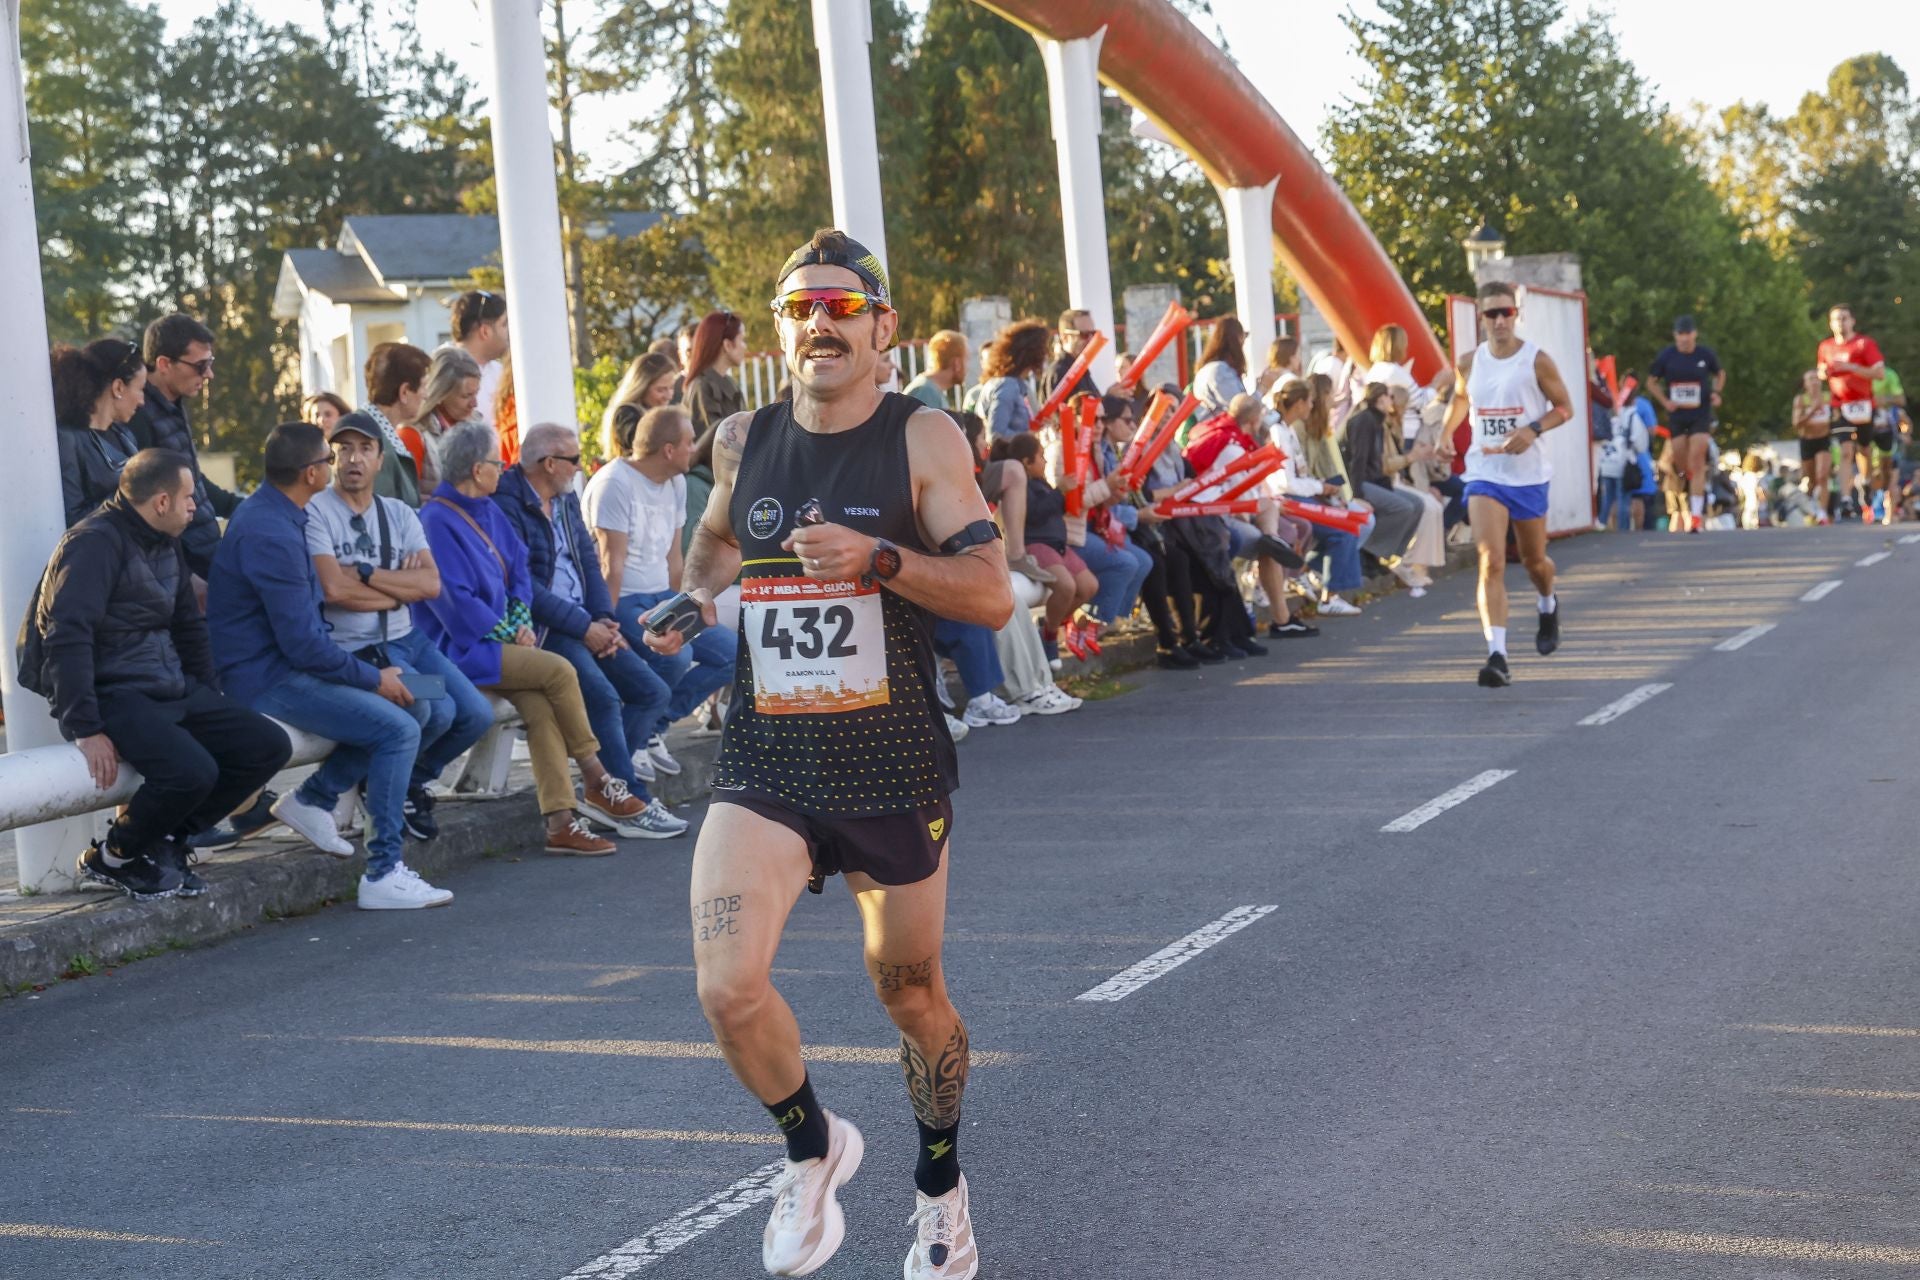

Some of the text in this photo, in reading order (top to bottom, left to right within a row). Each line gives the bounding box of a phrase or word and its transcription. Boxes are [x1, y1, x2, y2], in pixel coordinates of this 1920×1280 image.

[773, 585, 801, 595] MBA
[761, 604, 858, 660] 432
[693, 894, 741, 920] RIDE
[874, 956, 932, 977] LIVE
